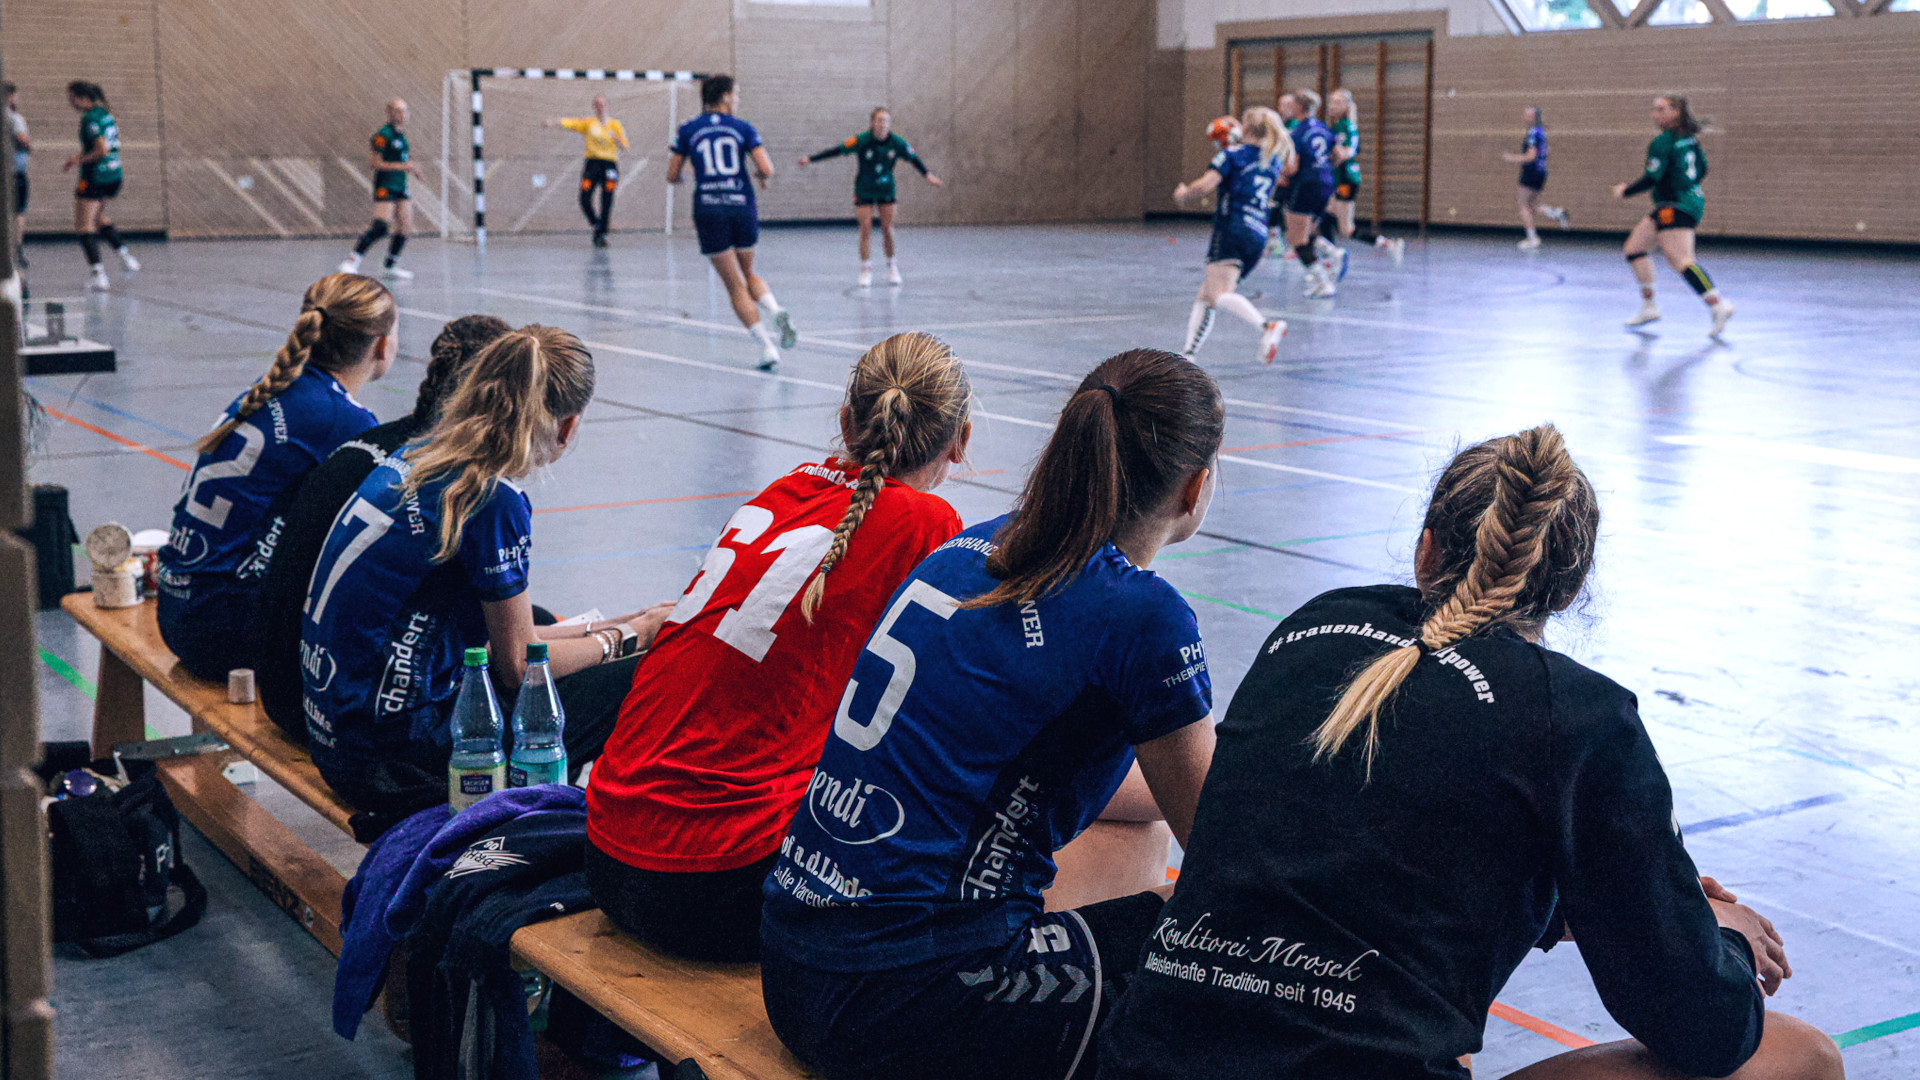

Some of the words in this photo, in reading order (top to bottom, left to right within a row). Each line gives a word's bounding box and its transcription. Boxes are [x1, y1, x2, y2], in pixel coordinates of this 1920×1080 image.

[696, 136, 741, 177] 10
[664, 505, 836, 664] 61
[384, 612, 429, 713] chandert
[834, 578, 962, 752] 5
[1162, 661, 1206, 688] THERAPIE
[1144, 951, 1206, 983] Meisterhafte
[1211, 965, 1270, 995] Tradition
[1274, 982, 1306, 1004] seit
[1311, 986, 1357, 1013] 1945
[1152, 912, 1251, 952] Konditorei
[1249, 936, 1380, 982] Mrosek
